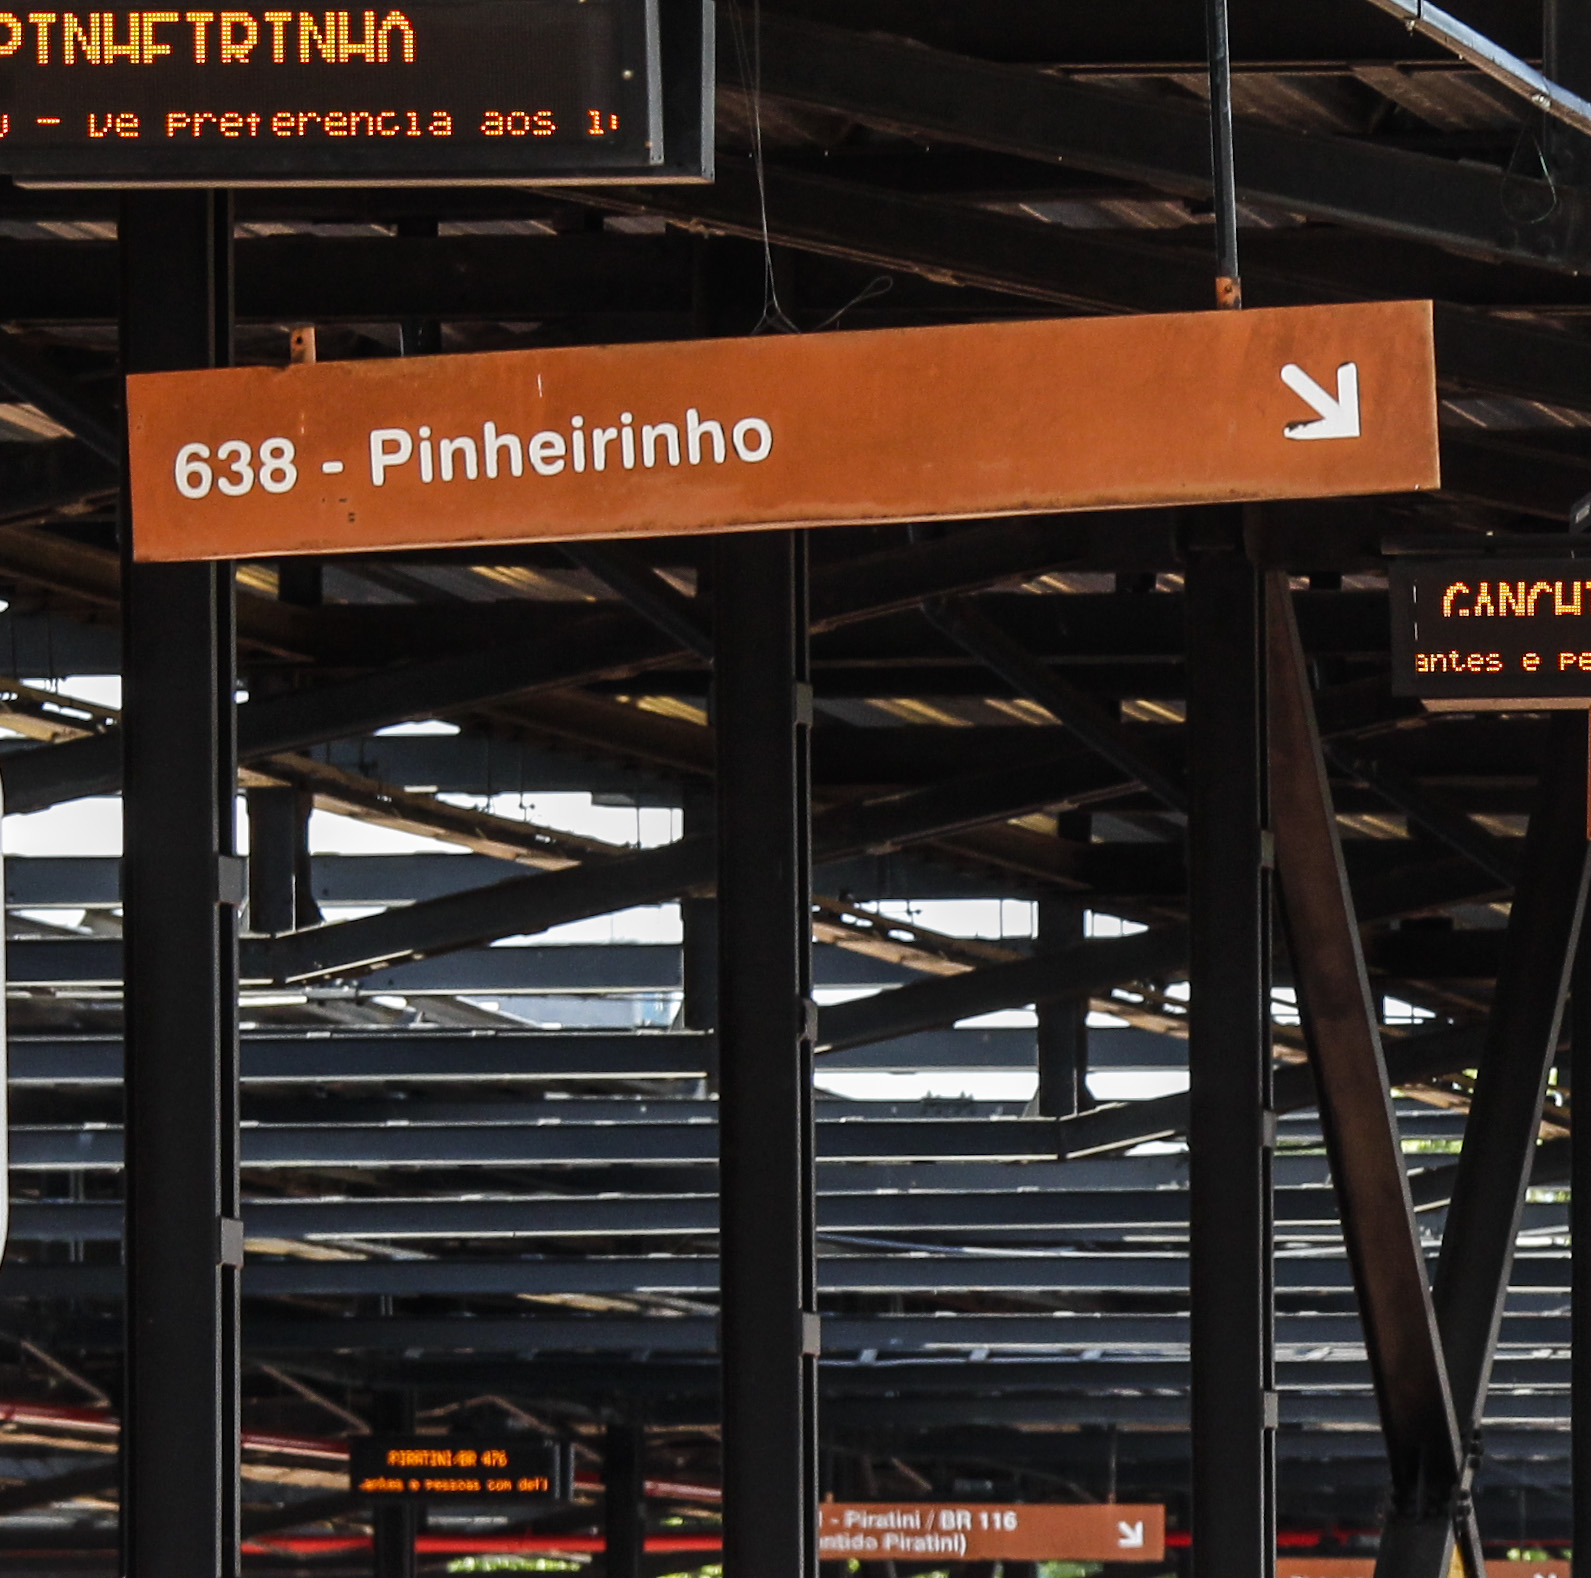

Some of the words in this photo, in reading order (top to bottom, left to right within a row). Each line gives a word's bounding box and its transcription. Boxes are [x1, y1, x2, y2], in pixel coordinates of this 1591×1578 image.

[479, 109, 559, 137] aos
[174, 436, 298, 499] 638
[369, 407, 774, 487] Pinheirinho
[1521, 651, 1543, 672] e
[844, 1510, 921, 1530] Piratini
[939, 1510, 973, 1531] BR
[979, 1511, 1019, 1531] 116
